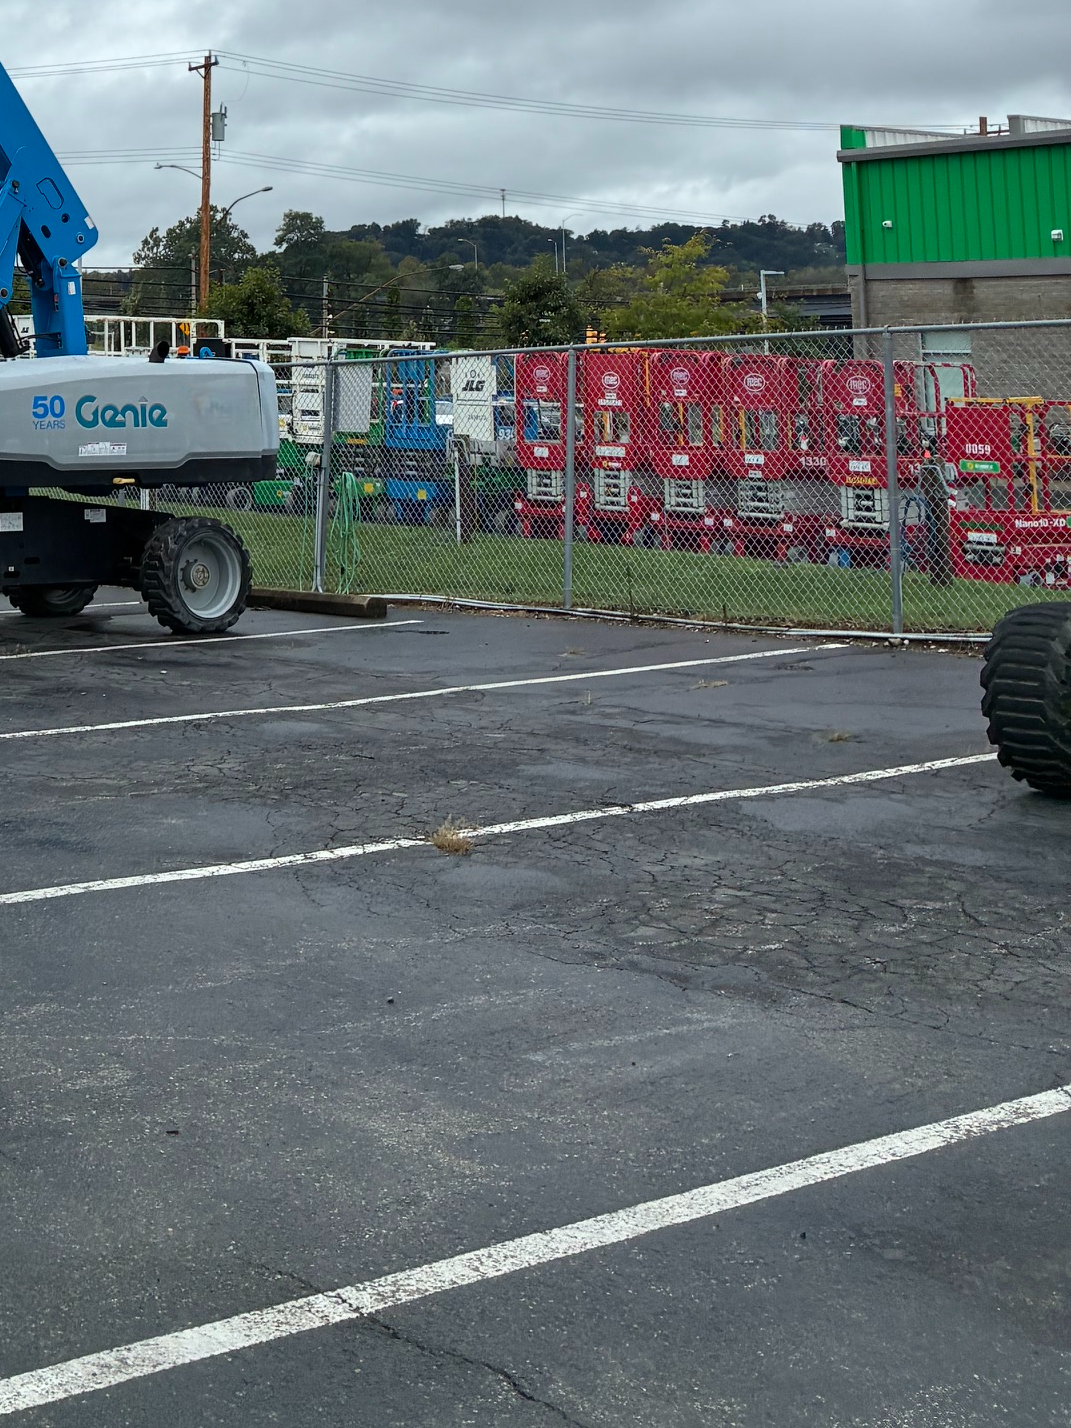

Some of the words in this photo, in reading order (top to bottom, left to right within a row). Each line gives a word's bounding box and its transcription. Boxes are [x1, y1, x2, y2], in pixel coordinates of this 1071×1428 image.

[461, 380, 485, 391] JLG
[32, 395, 65, 419] 50
[75, 395, 168, 428] Genie
[32, 420, 65, 430] YEARS
